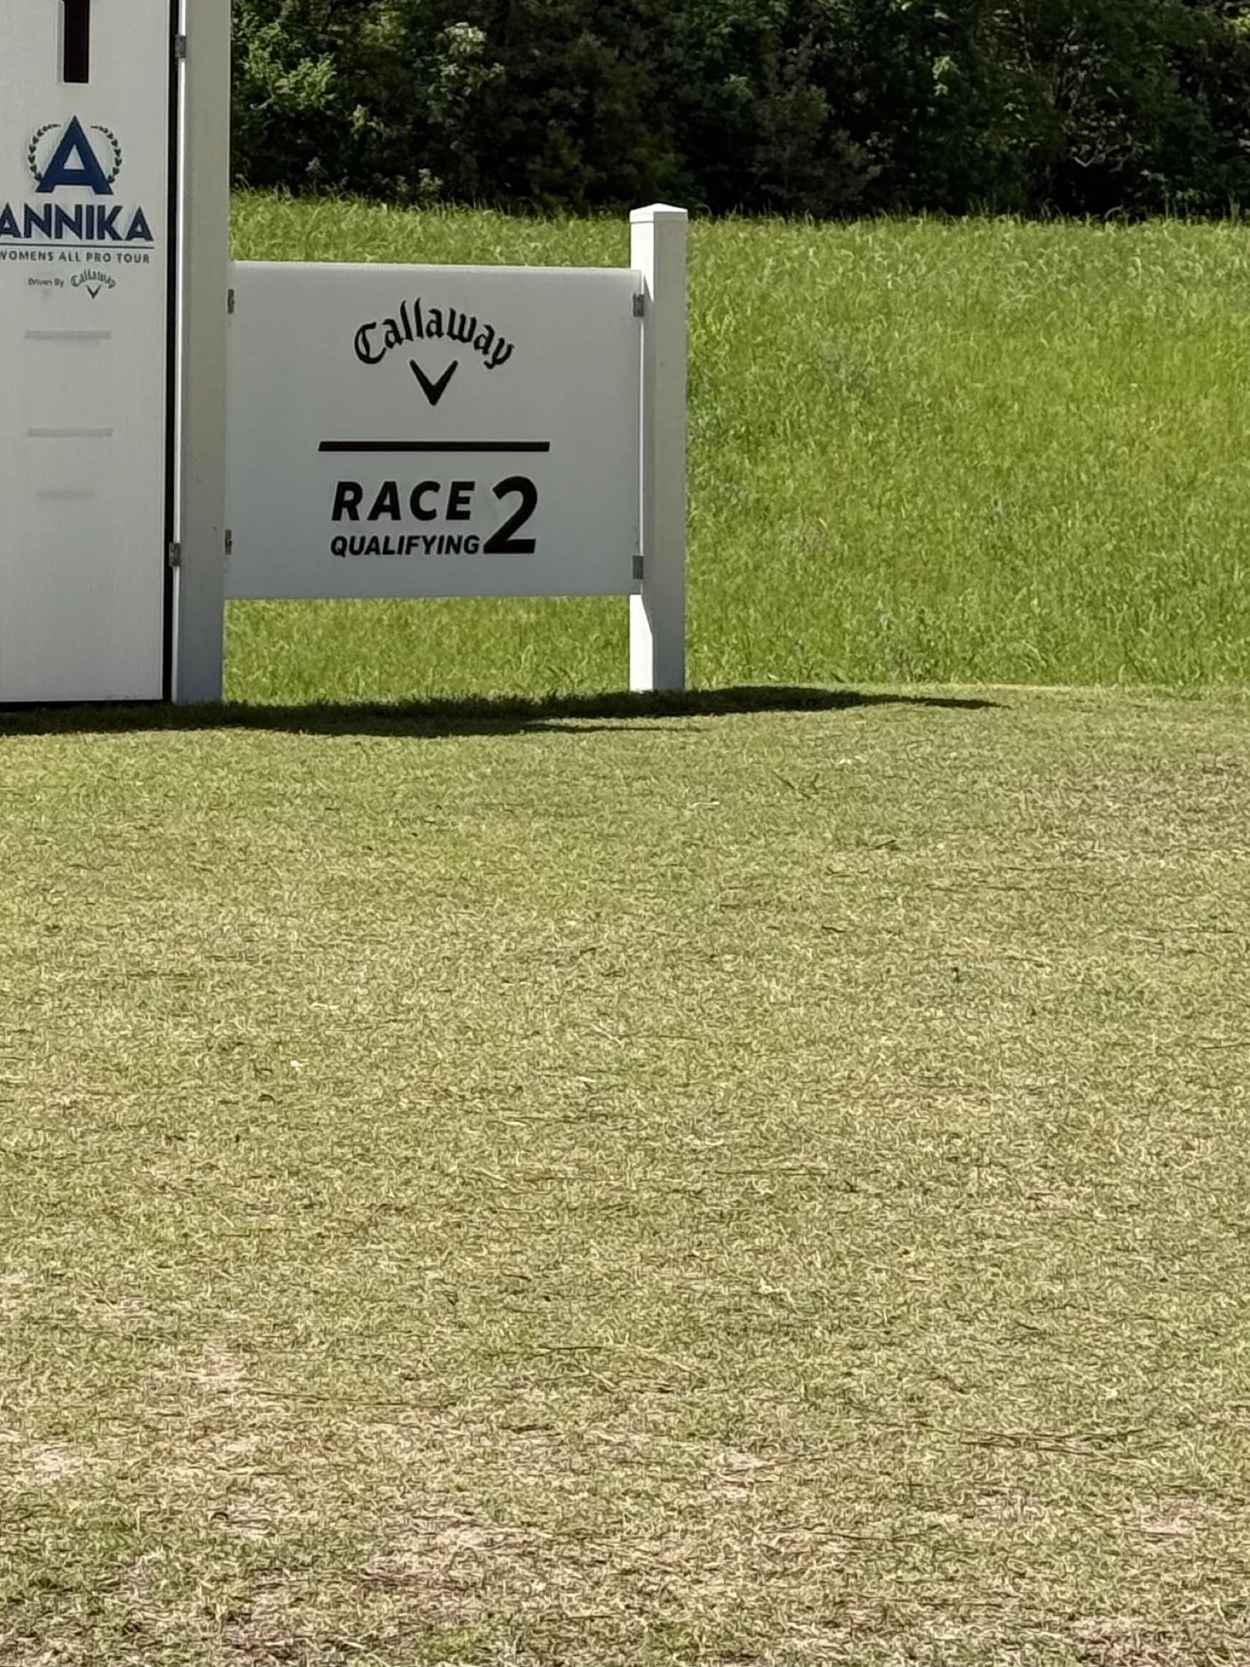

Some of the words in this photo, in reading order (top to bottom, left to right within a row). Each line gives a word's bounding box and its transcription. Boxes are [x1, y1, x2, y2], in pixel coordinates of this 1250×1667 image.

[58, 251, 81, 263] ALL
[86, 252, 111, 263] PRO
[116, 253, 150, 264] TOUR
[70, 268, 116, 289] Callaway
[354, 297, 515, 369] Callaway
[331, 480, 475, 521] RACE
[483, 476, 538, 554] 2
[330, 534, 480, 557] QUALIFYING
